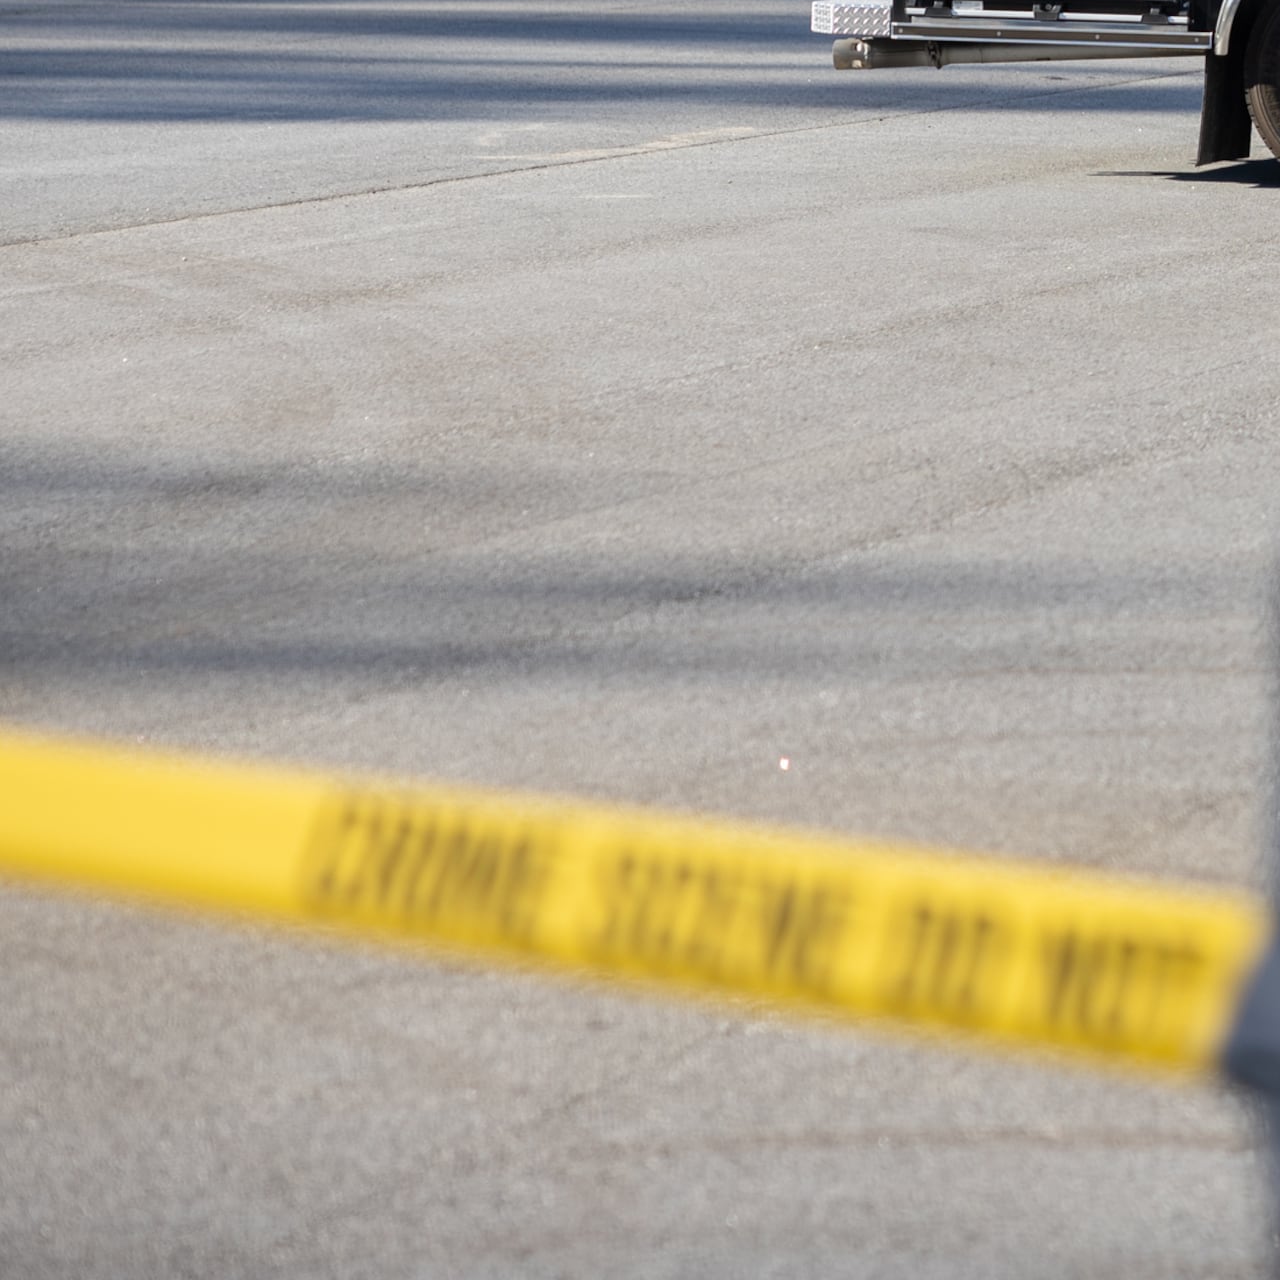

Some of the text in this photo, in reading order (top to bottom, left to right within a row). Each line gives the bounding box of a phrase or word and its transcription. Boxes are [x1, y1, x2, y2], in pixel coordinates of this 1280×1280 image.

[312, 802, 1208, 1050] CRIME SCENE DO NOT
